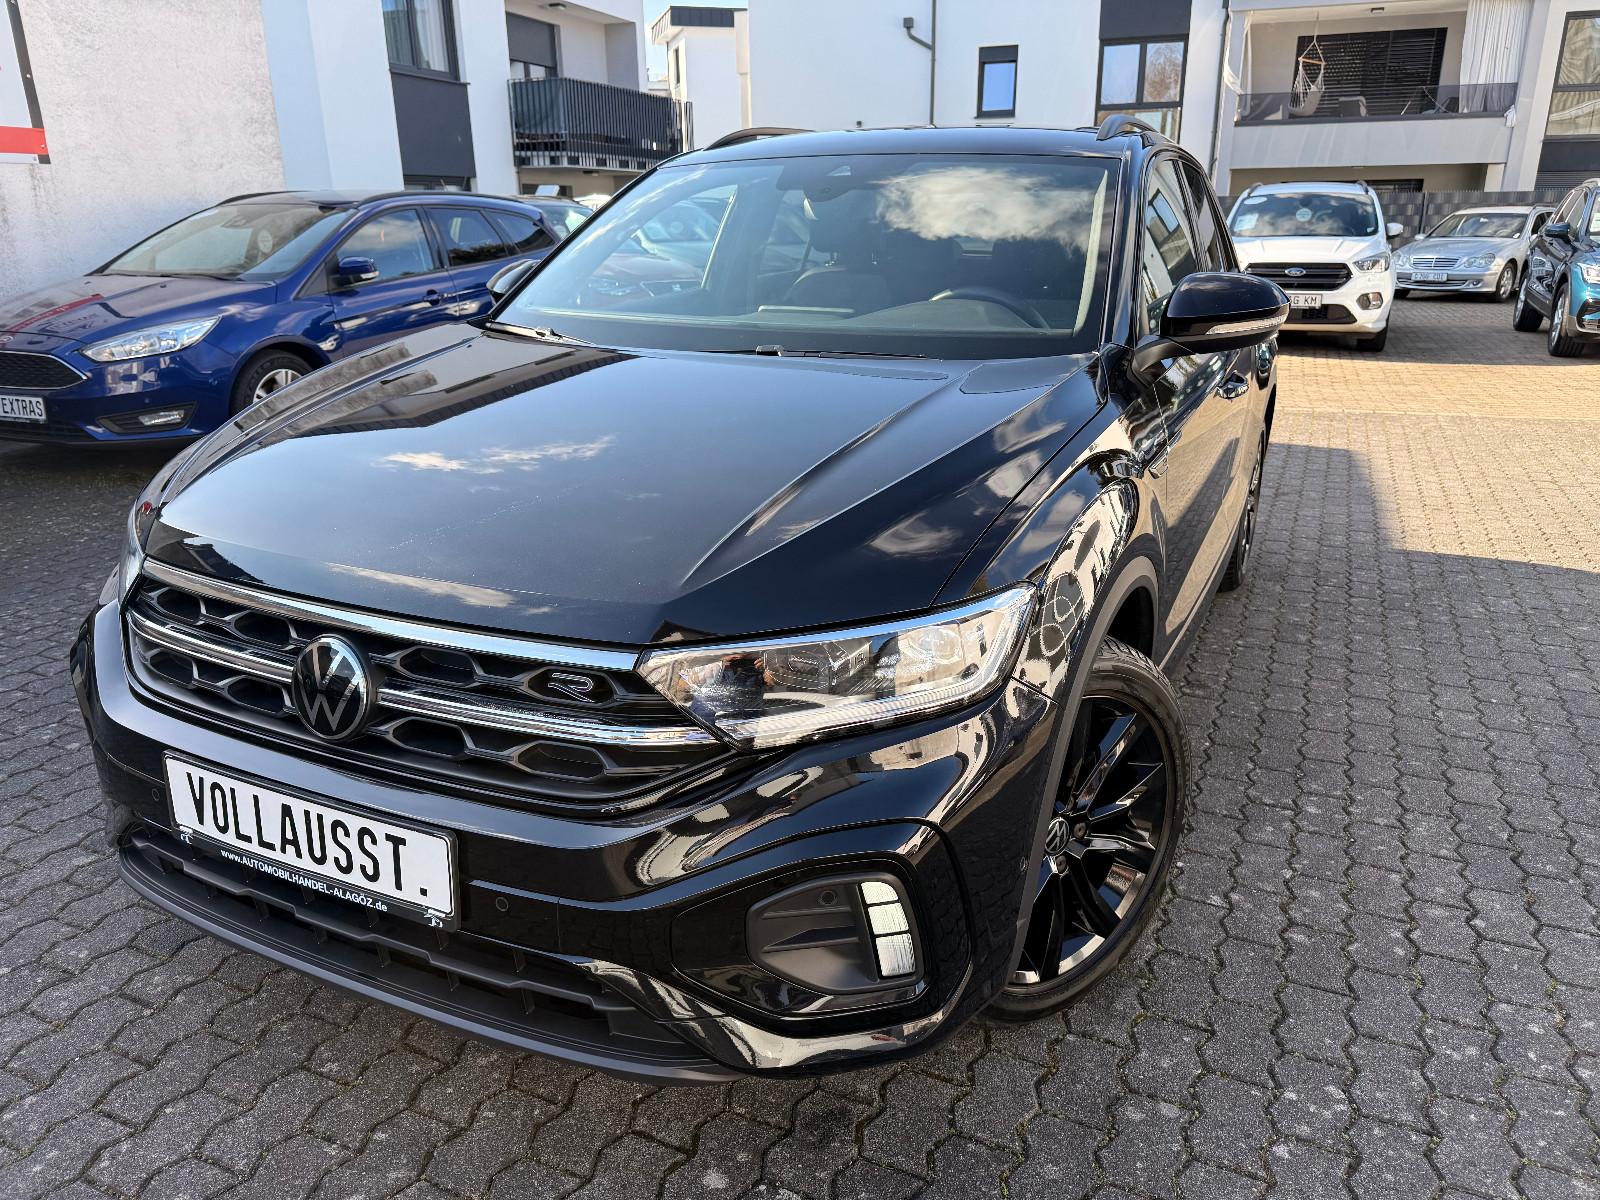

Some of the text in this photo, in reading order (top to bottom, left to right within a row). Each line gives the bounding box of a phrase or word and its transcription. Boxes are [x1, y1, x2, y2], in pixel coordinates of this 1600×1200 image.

[1303, 295, 1318, 305] KM
[2, 398, 43, 417] EXTRAS
[220, 849, 388, 912] www.AUTOMOBILHANDEL-ALAGÖZ.de
